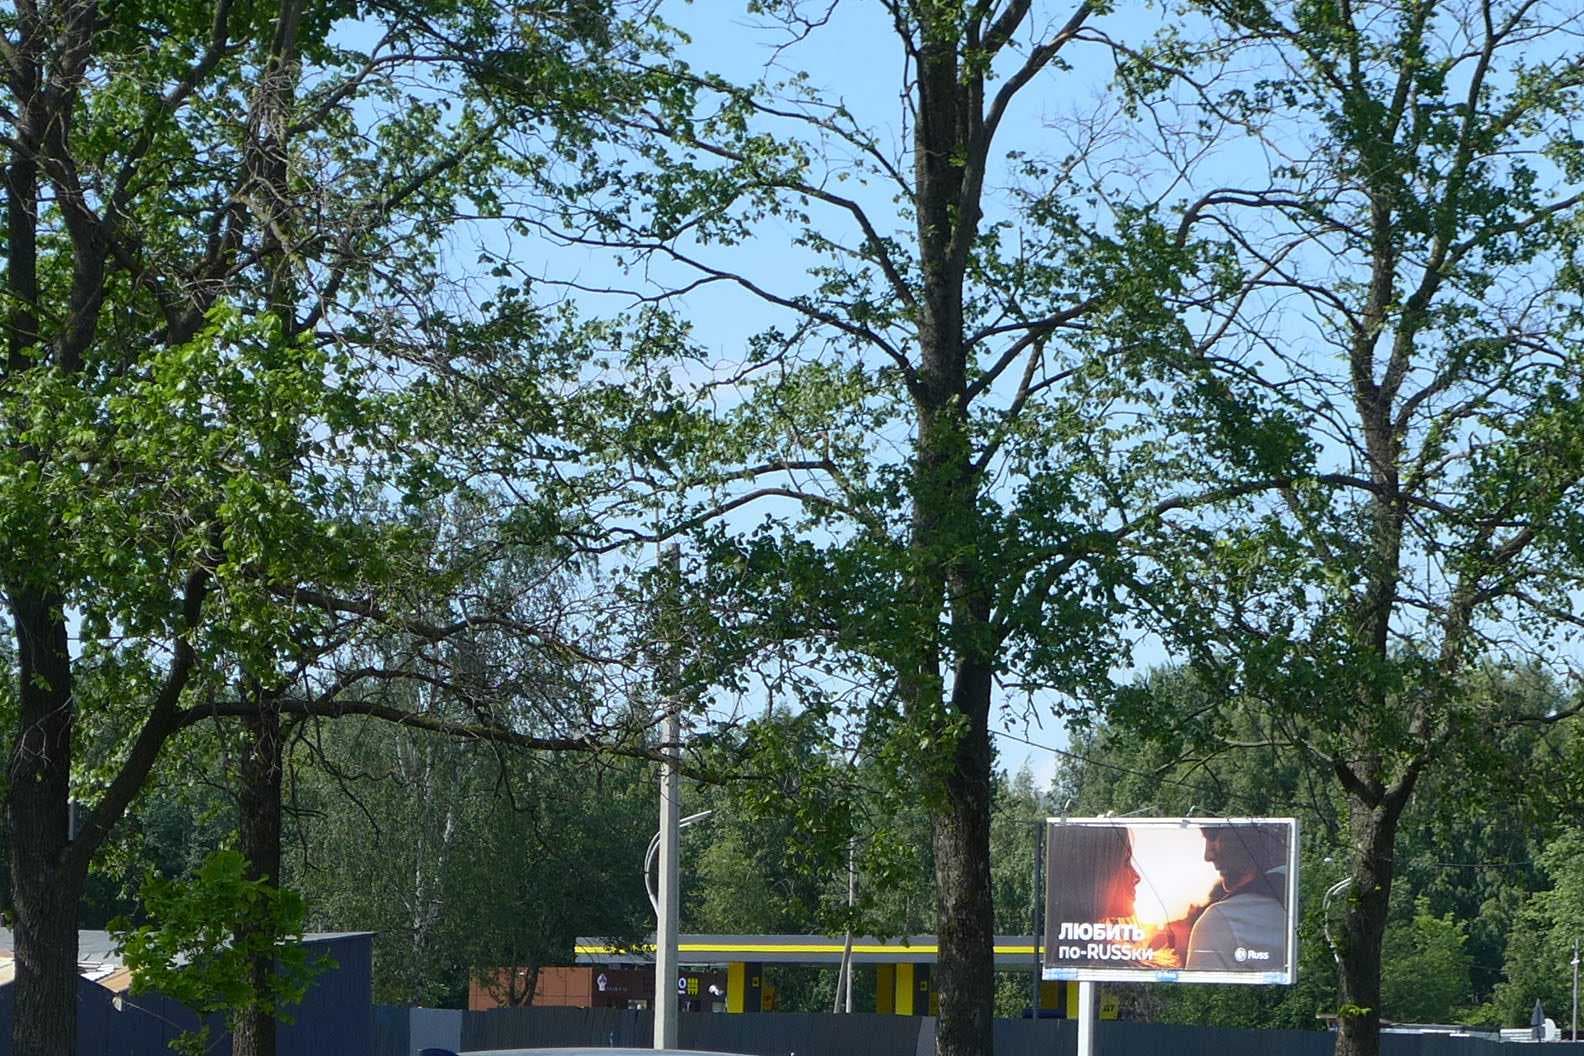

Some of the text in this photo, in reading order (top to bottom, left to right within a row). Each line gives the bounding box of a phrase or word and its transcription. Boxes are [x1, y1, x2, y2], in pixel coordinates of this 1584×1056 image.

[1058, 922, 1146, 940] ЛЮБИТЬ
[1058, 944, 1153, 961] по-RUSSки
[1247, 949, 1270, 960] Russ
